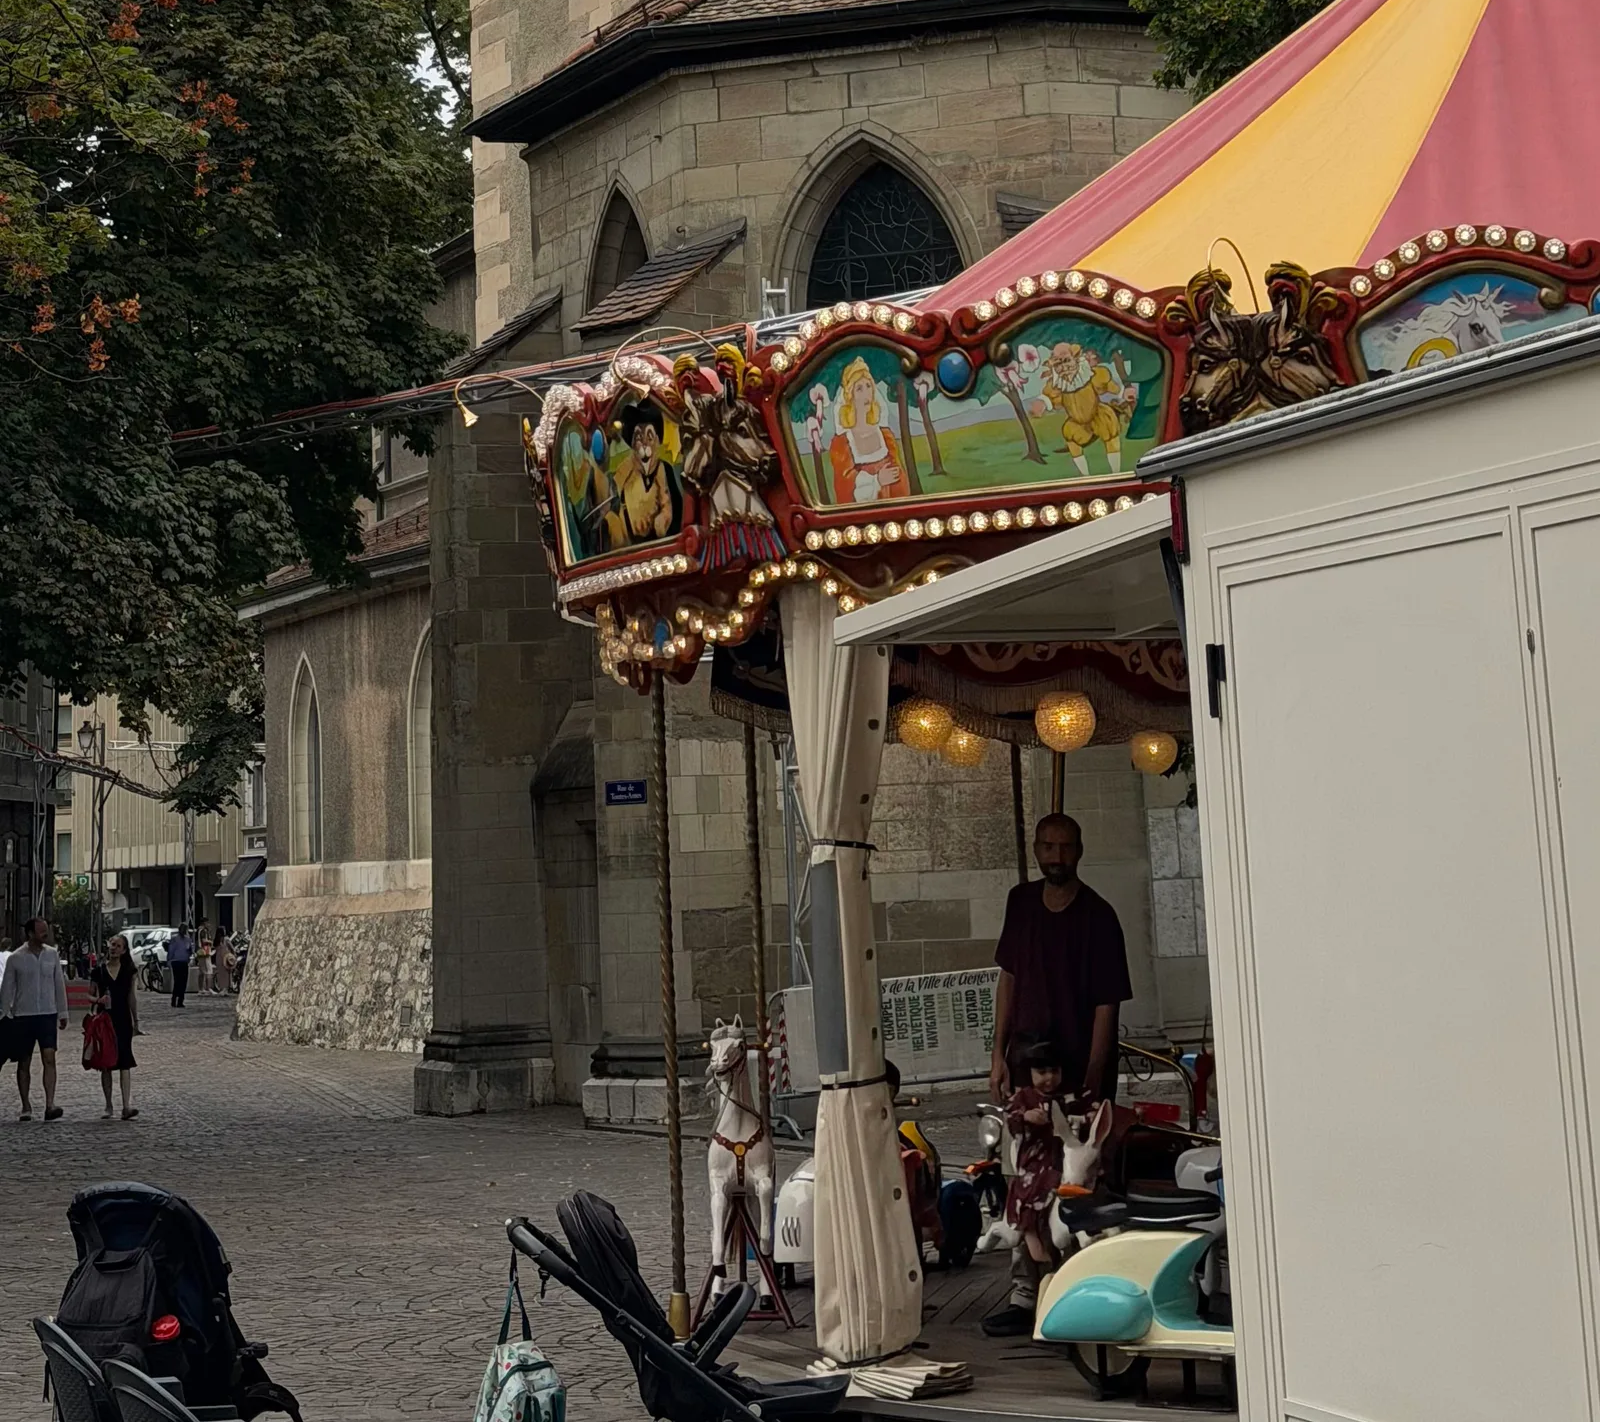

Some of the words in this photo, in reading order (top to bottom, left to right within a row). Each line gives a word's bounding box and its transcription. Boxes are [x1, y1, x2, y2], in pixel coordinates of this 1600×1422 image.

[628, 783, 635, 792] de
[889, 979, 903, 995] de
[905, 978, 916, 993] la
[918, 975, 941, 991] Ville
[943, 973, 957, 989] de
[958, 971, 999, 987] Genève
[881, 998, 895, 1041] CHAMPEL
[895, 996, 909, 1040] FUSTERIE
[923, 994, 939, 1049] NAVIGATION
[965, 989, 979, 1028] LIOTARD
